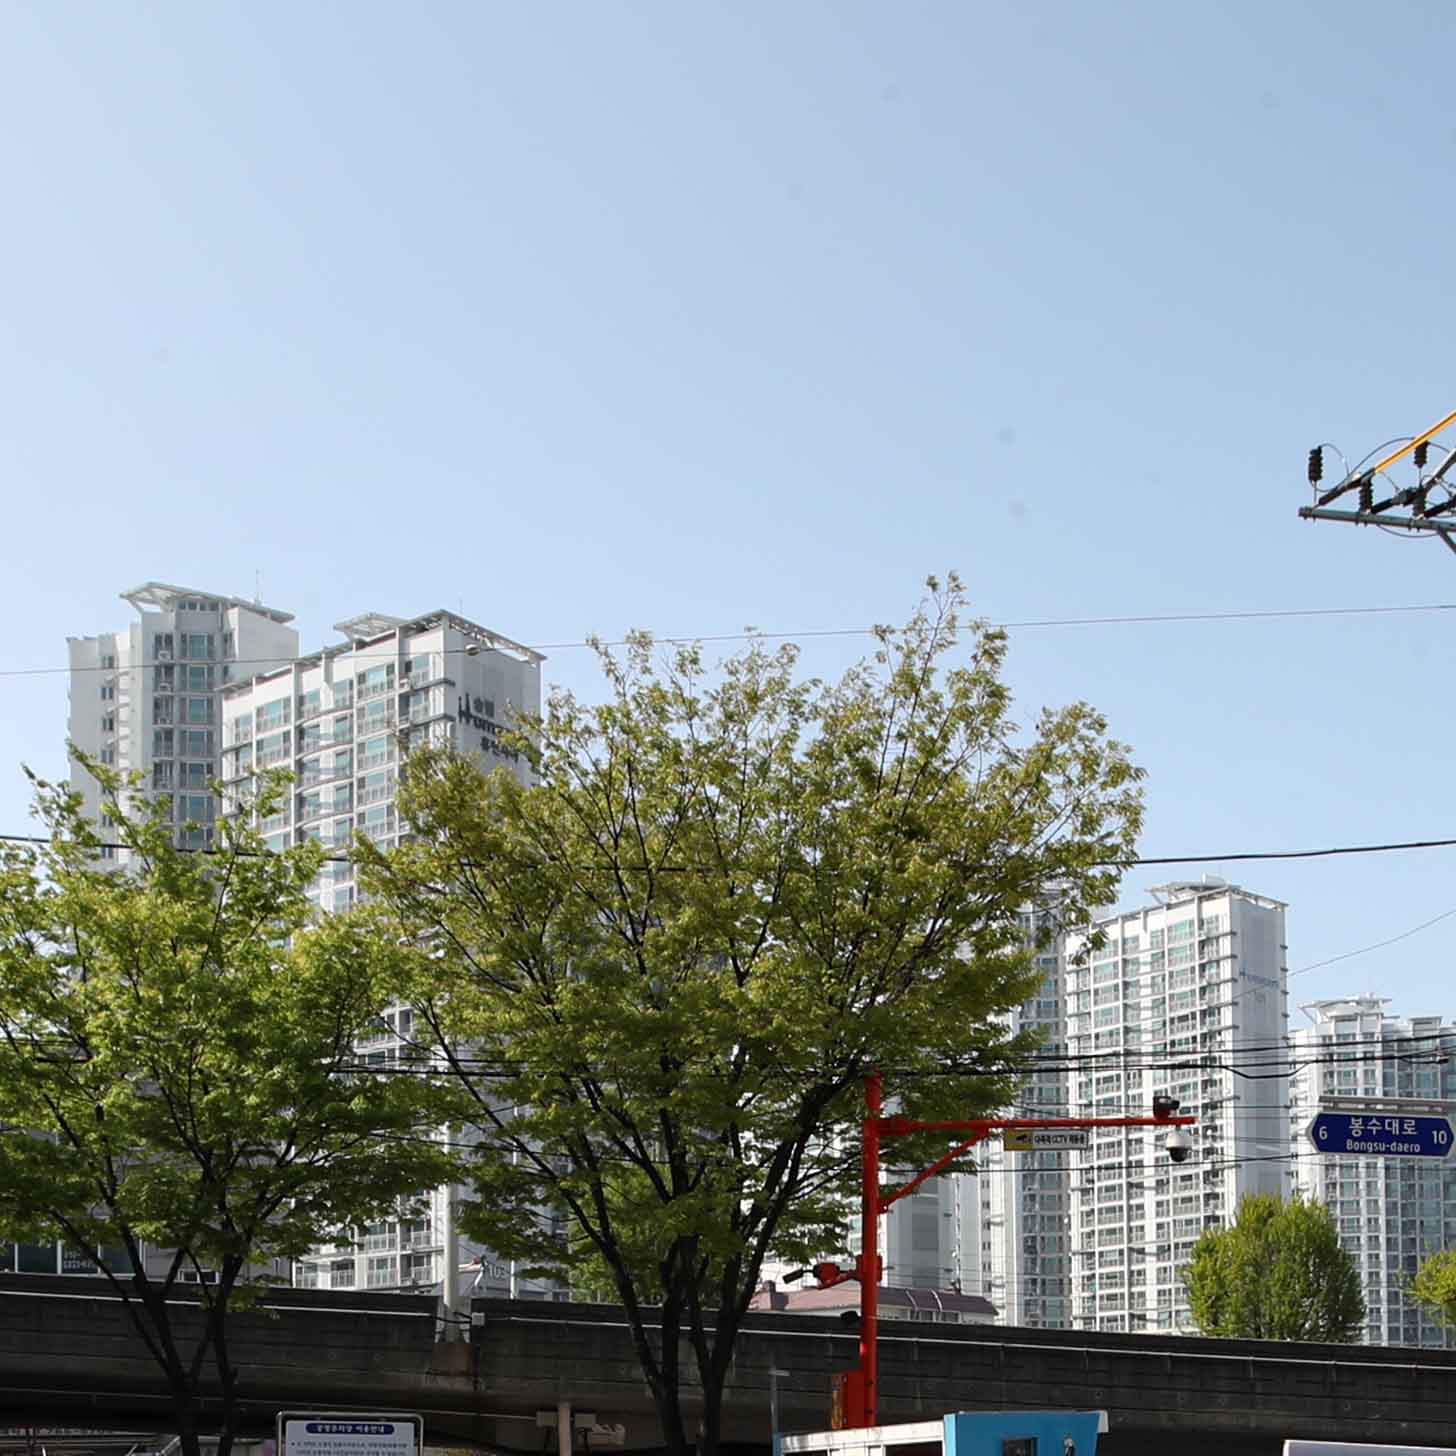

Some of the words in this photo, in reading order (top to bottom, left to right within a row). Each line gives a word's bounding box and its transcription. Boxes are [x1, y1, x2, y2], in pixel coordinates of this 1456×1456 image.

[1318, 1126, 1328, 1140] 6
[1349, 1117, 1417, 1137] 봉수대로
[1431, 1130, 1448, 1145] 10
[1346, 1139, 1421, 1153] Bongsu-daero
